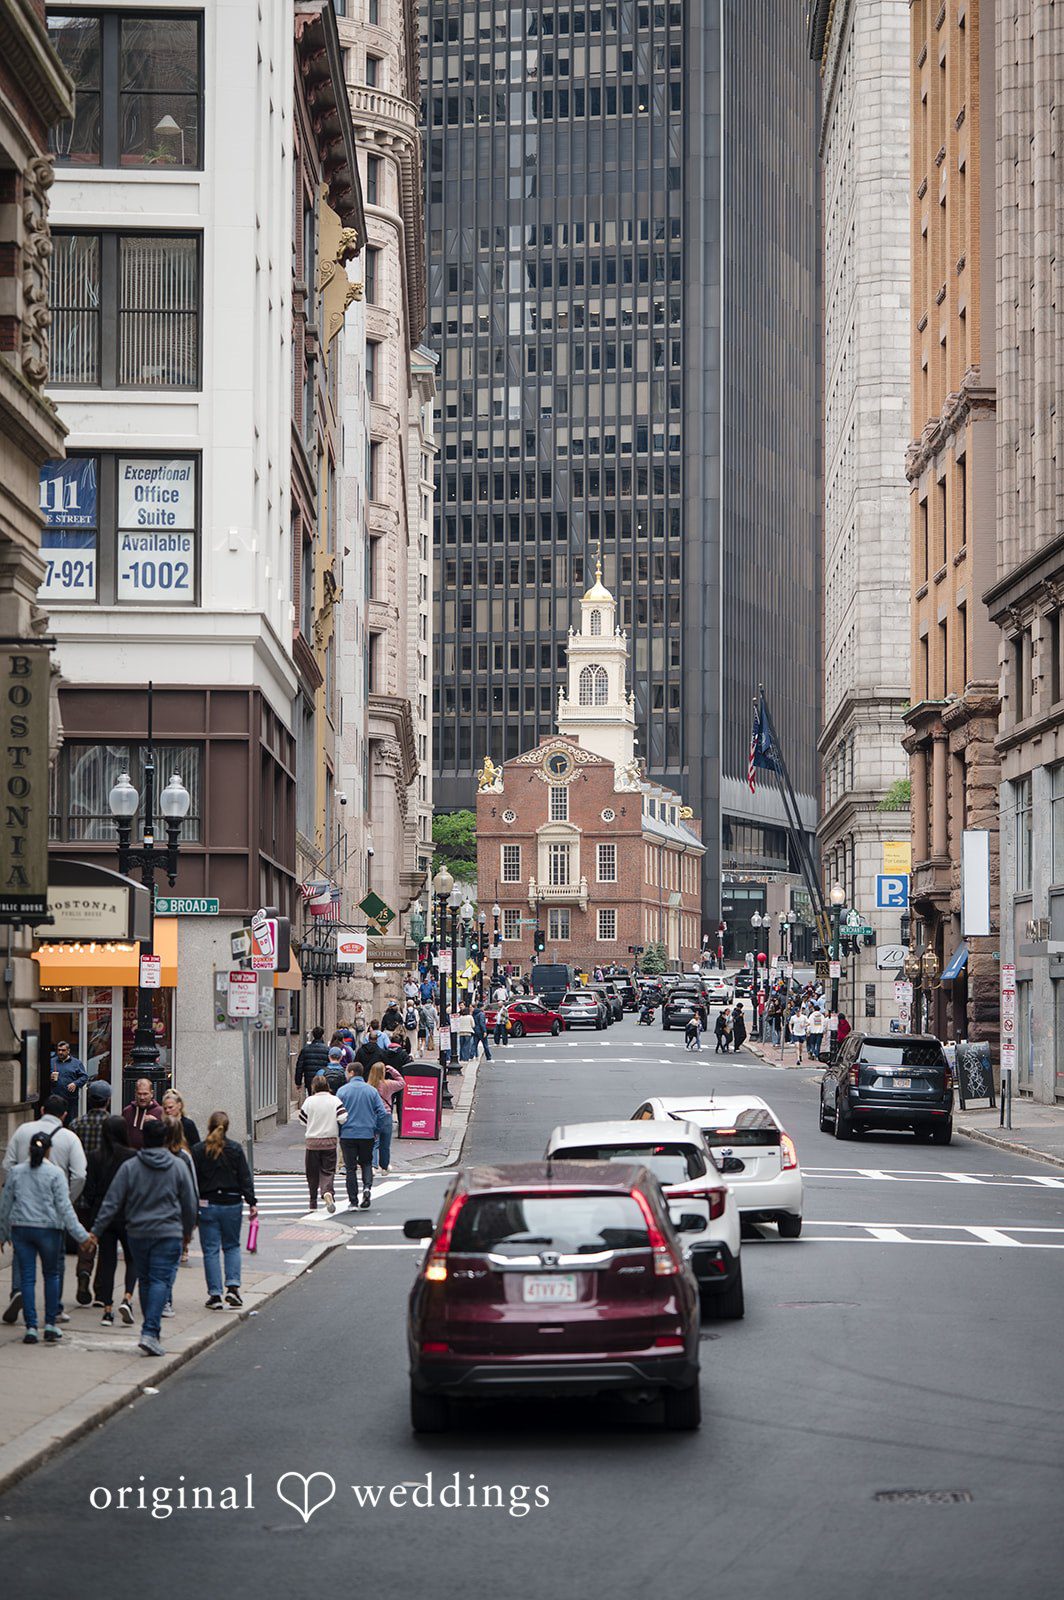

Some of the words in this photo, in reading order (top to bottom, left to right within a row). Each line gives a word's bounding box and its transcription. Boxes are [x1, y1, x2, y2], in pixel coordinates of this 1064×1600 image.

[124, 466, 191, 483] Exceptional
[134, 485, 179, 503] Office
[55, 515, 92, 523] STREET
[137, 508, 176, 525] Suite
[122, 535, 191, 551] Available
[122, 562, 189, 589] -1002
[7, 655, 32, 888] BOSTONIA
[0, 903, 18, 911] BLIC
[21, 903, 43, 912] HOUSE
[170, 899, 208, 912] BROAD
